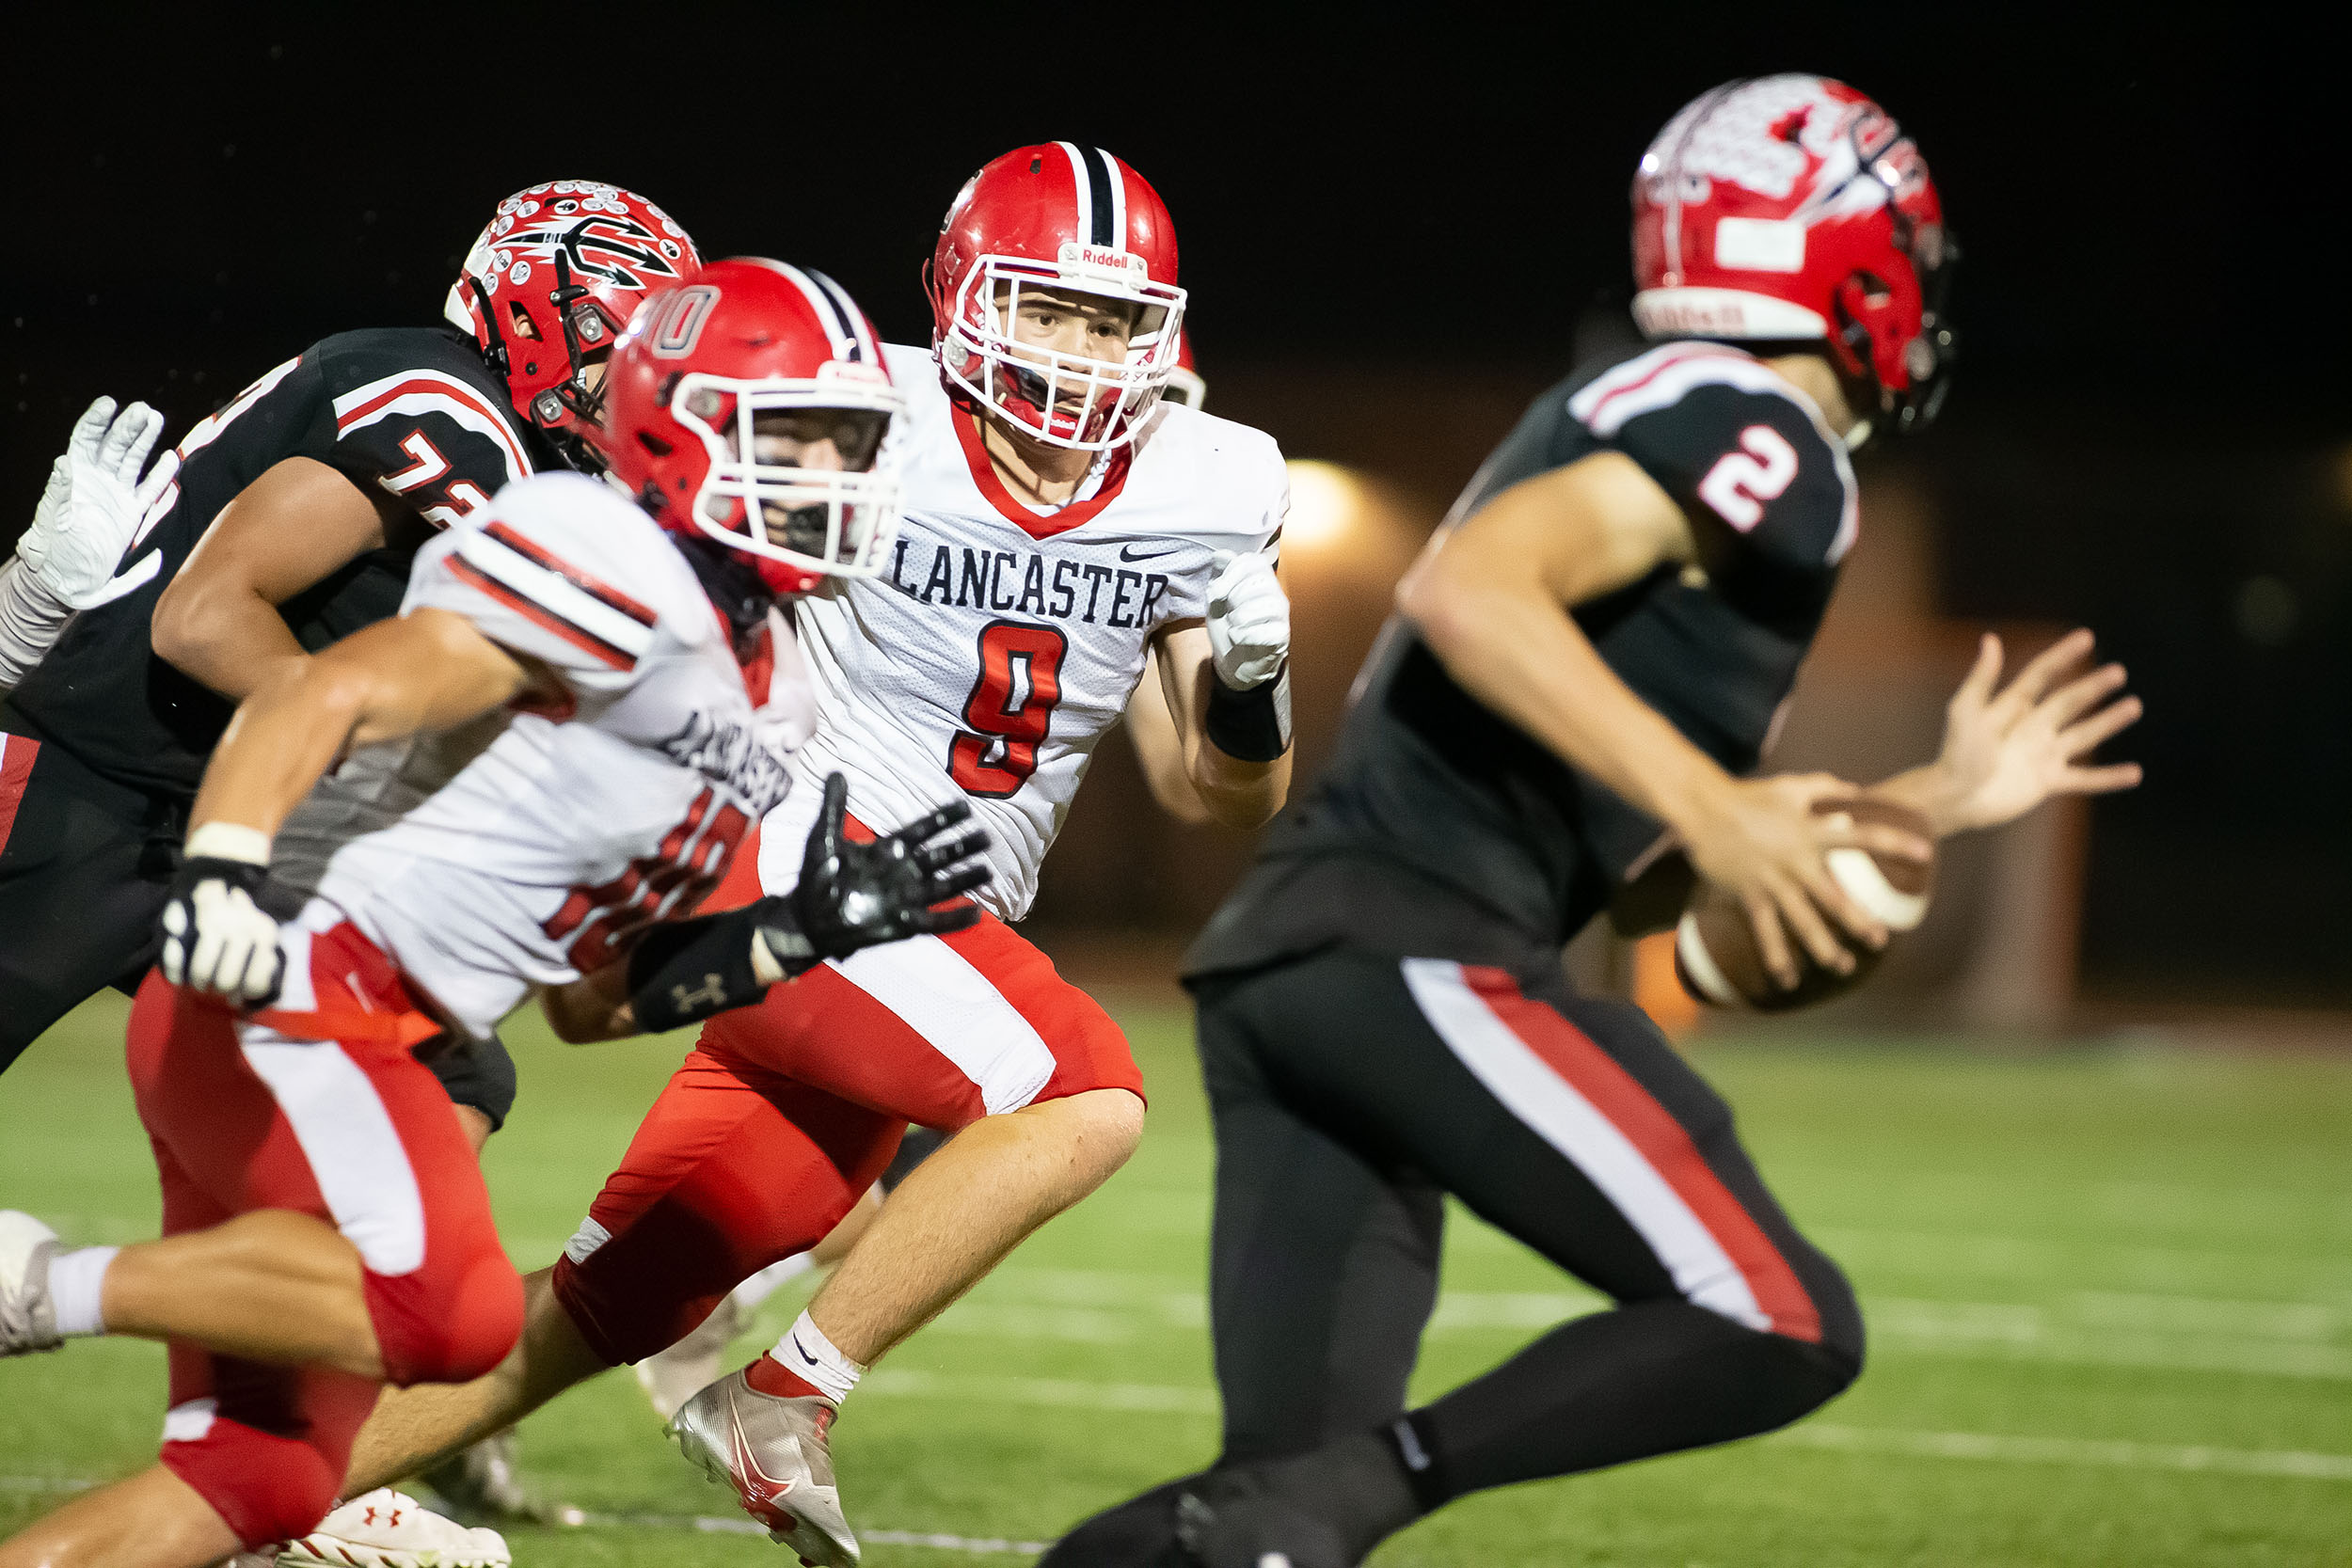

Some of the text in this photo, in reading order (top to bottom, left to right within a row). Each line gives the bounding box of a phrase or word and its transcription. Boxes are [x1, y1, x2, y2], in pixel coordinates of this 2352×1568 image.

[1083, 248, 1128, 269] Riddell
[1697, 423, 1800, 533] 2
[893, 539, 1168, 629] LANCASTER
[946, 619, 1069, 800] 9
